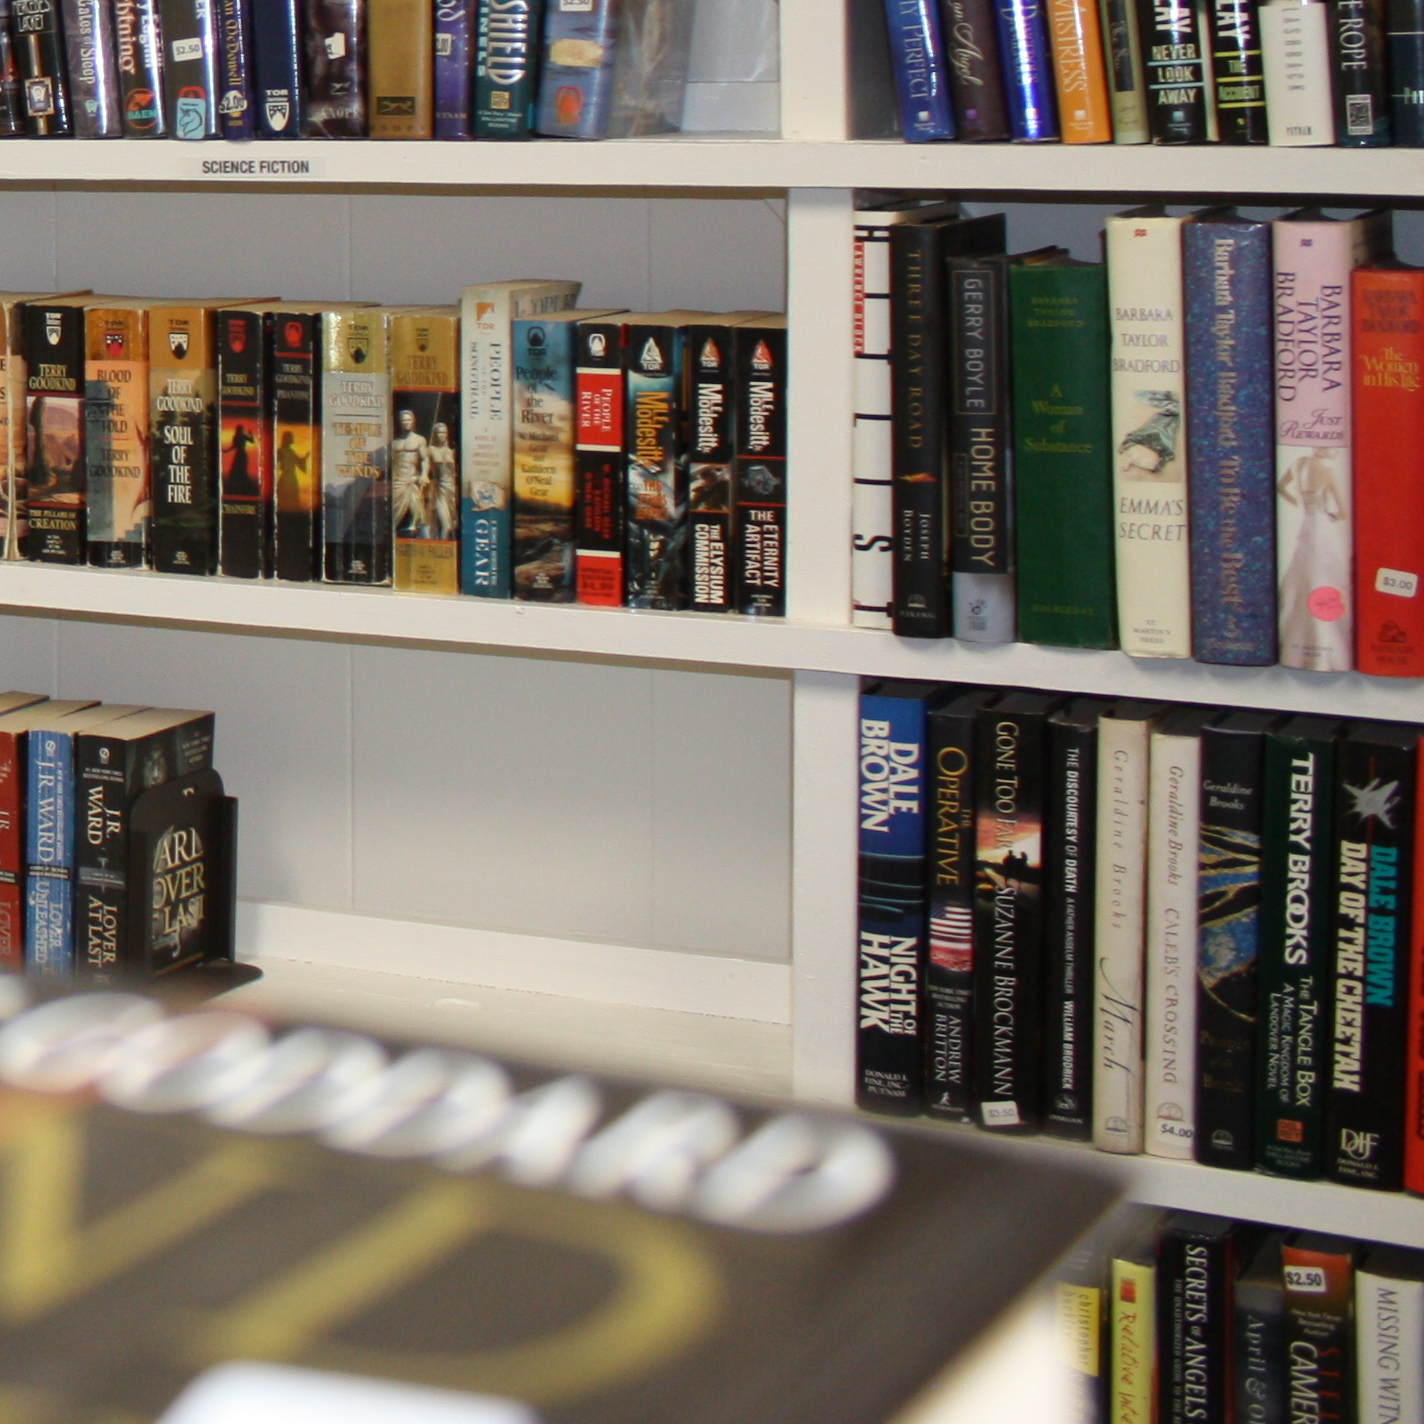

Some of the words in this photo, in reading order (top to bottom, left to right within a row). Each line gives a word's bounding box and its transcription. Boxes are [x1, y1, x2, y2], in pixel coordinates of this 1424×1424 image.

[176, 44, 199, 56] $2.50
[1152, 43, 1196, 61] NEVER
[1338, 18, 1368, 72] ROPE
[1158, 65, 1194, 84] LOOK
[1158, 88, 1197, 106] AWAY
[202, 160, 255, 173] SCIENCE
[260, 160, 310, 173] FICTION
[964, 278, 983, 341] GERRY
[1115, 307, 1173, 322] BARBARA
[1276, 271, 1296, 402] BRADFORD
[908, 334, 923, 376] DAY
[1114, 358, 1180, 374] BRADFORD
[1121, 333, 1169, 347] TAYLOR
[1297, 297, 1319, 381] TAYLOR
[1321, 284, 1343, 393] BARBARA
[29, 376, 76, 391] GOODKIND
[38, 363, 68, 378] TERRY
[516, 366, 557, 380] People
[965, 348, 985, 409] BOYLE
[164, 425, 194, 445] SOUL
[520, 409, 554, 424] River
[581, 391, 592, 428] RIVER
[602, 388, 613, 432] PEOPLE
[909, 387, 923, 449] ROAD
[169, 465, 191, 485] THE
[172, 446, 188, 463] OF
[167, 484, 192, 504] FIRE
[749, 510, 774, 522] THE
[1119, 497, 1186, 515] EMMA'S
[28, 518, 76, 531] CREATION
[475, 518, 490, 586] GEAR
[1119, 522, 1187, 541] SECRET
[695, 523, 710, 604] COMMISSION
[709, 542, 725, 604] ELYSIUM
[745, 525, 761, 586] ARTIFACT
[762, 525, 779, 588] ETERNITY
[995, 721, 1020, 771] GONE
[1066, 748, 1079, 768] THE
[861, 718, 890, 832] BROWN
[888, 741, 920, 815] DALE
[995, 776, 1018, 813] TOO
[1113, 749, 1129, 850] Geraldine
[1167, 765, 1184, 837] Geraldine
[1287, 751, 1315, 850] TERRY
[36, 797, 55, 862] WARD
[87, 785, 103, 845] WARD
[936, 746, 968, 886] OPERATIVE
[1065, 769, 1080, 842] DISCOURTESY
[1065, 859, 1077, 893] DEATH
[1167, 840, 1183, 887] Brooks
[1339, 840, 1367, 889] DAY
[1369, 844, 1398, 909] DALE
[1112, 863, 1127, 930] Brooks
[1284, 853, 1310, 965] BROOKS
[1338, 891, 1366, 924] OF
[87, 928, 103, 967] LAST
[103, 903, 118, 963] LOVER
[994, 886, 1017, 970] SUZANNE
[1337, 927, 1365, 976] THE
[860, 931, 891, 1035] HAWK
[890, 936, 917, 1016] NIGHT
[905, 1019, 917, 1036] OF
[1366, 914, 1396, 1007] BROWN
[890, 1012, 902, 1035] THE
[934, 1014, 948, 1082] BRITTON
[948, 1016, 962, 1084] ANDREW
[993, 976, 1017, 1096] BROCKMANN
[1162, 984, 1179, 1086] CROSSING
[1296, 1000, 1318, 1066] TANGLE
[1333, 979, 1363, 1093] CHEETAH
[1295, 1070, 1316, 1108] BOX
[1161, 1124, 1193, 1139] $4.00
[1185, 1244, 1208, 1324] SECRETS
[1286, 1269, 1322, 1287] $2.50
[1376, 1287, 1400, 1373] MISSING
[1184, 1338, 1207, 1421] ANGELS
